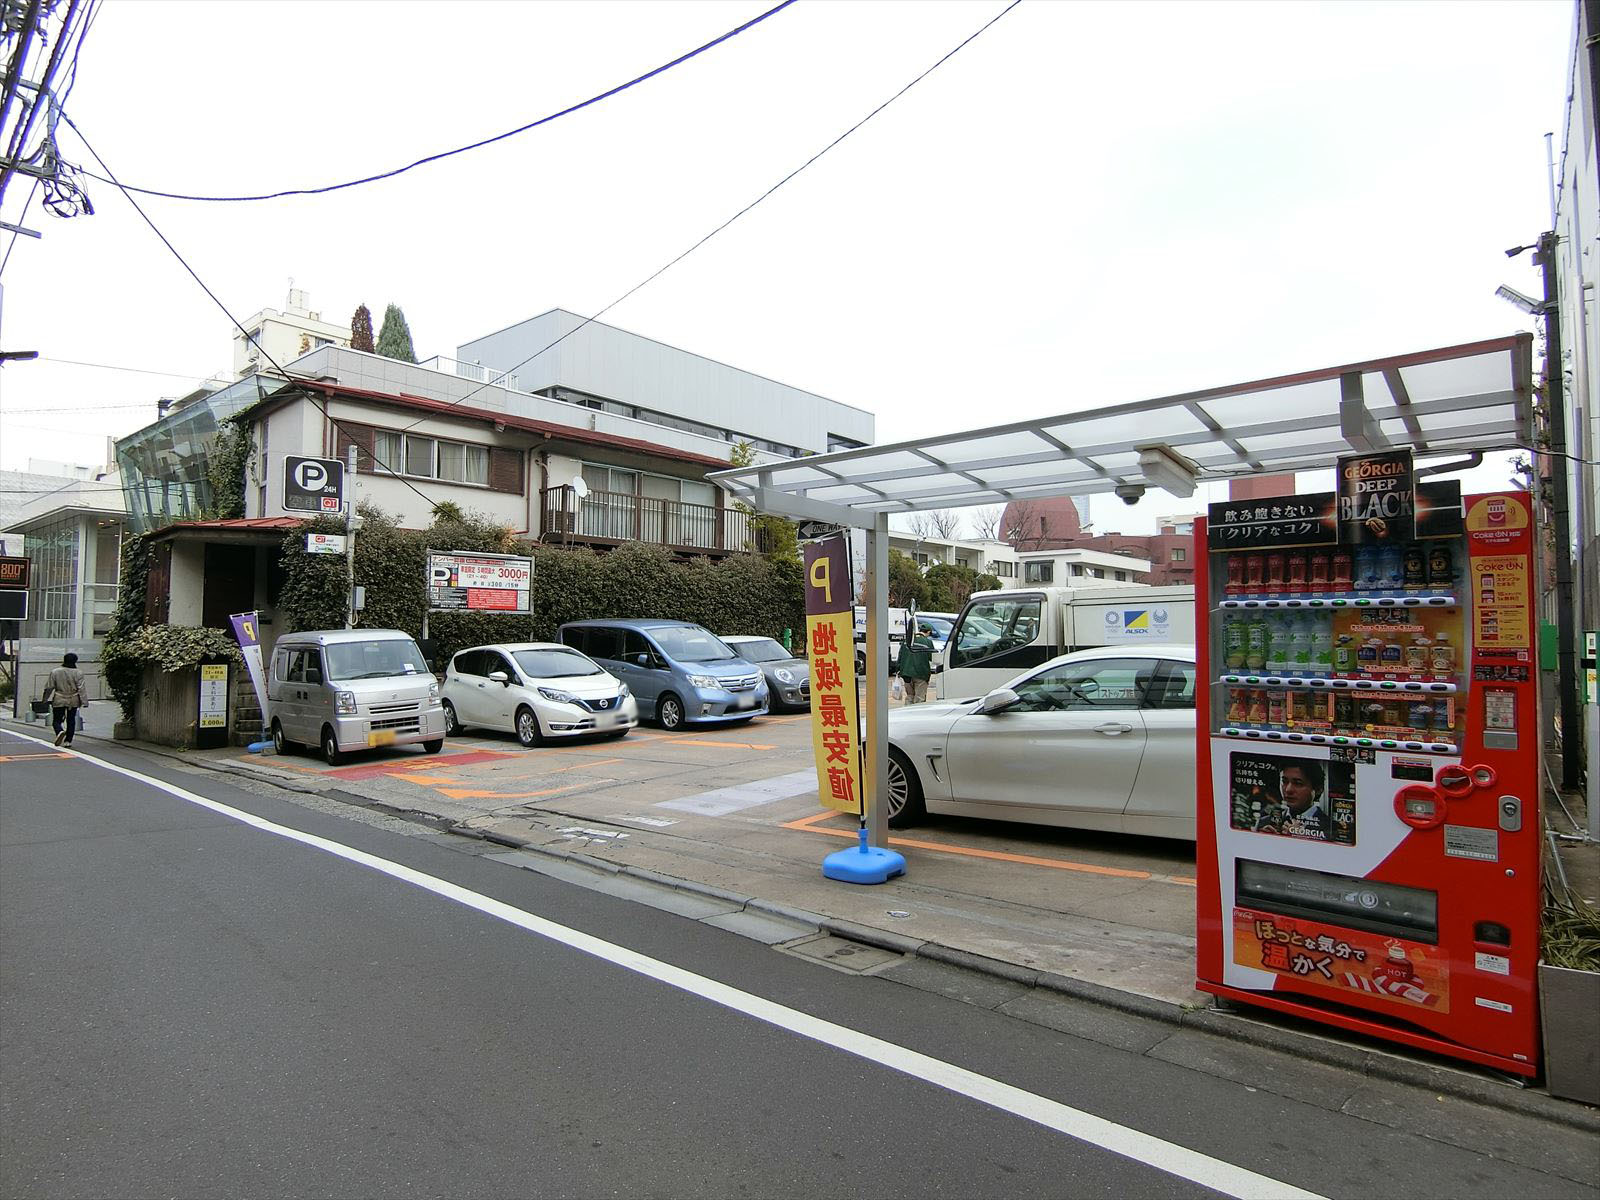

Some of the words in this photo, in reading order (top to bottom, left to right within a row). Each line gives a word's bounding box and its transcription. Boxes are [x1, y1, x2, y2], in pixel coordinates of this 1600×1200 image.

[302, 464, 324, 487] P
[1344, 461, 1405, 479] GEORGIA
[1355, 480, 1397, 493] DEEP
[1225, 505, 1314, 522] 飲み飽きない
[1340, 491, 1412, 521] BLACK
[812, 524, 826, 533] ONE
[1218, 522, 1320, 540] 「クリアなコク」
[1476, 563, 1504, 572] Coke
[1506, 562, 1524, 570] ON
[1289, 826, 1324, 838] GEORGIA
[1255, 920, 1367, 962] ほっとな気分で
[1262, 942, 1334, 979] 温かく
[1388, 969, 1407, 978] HOT
